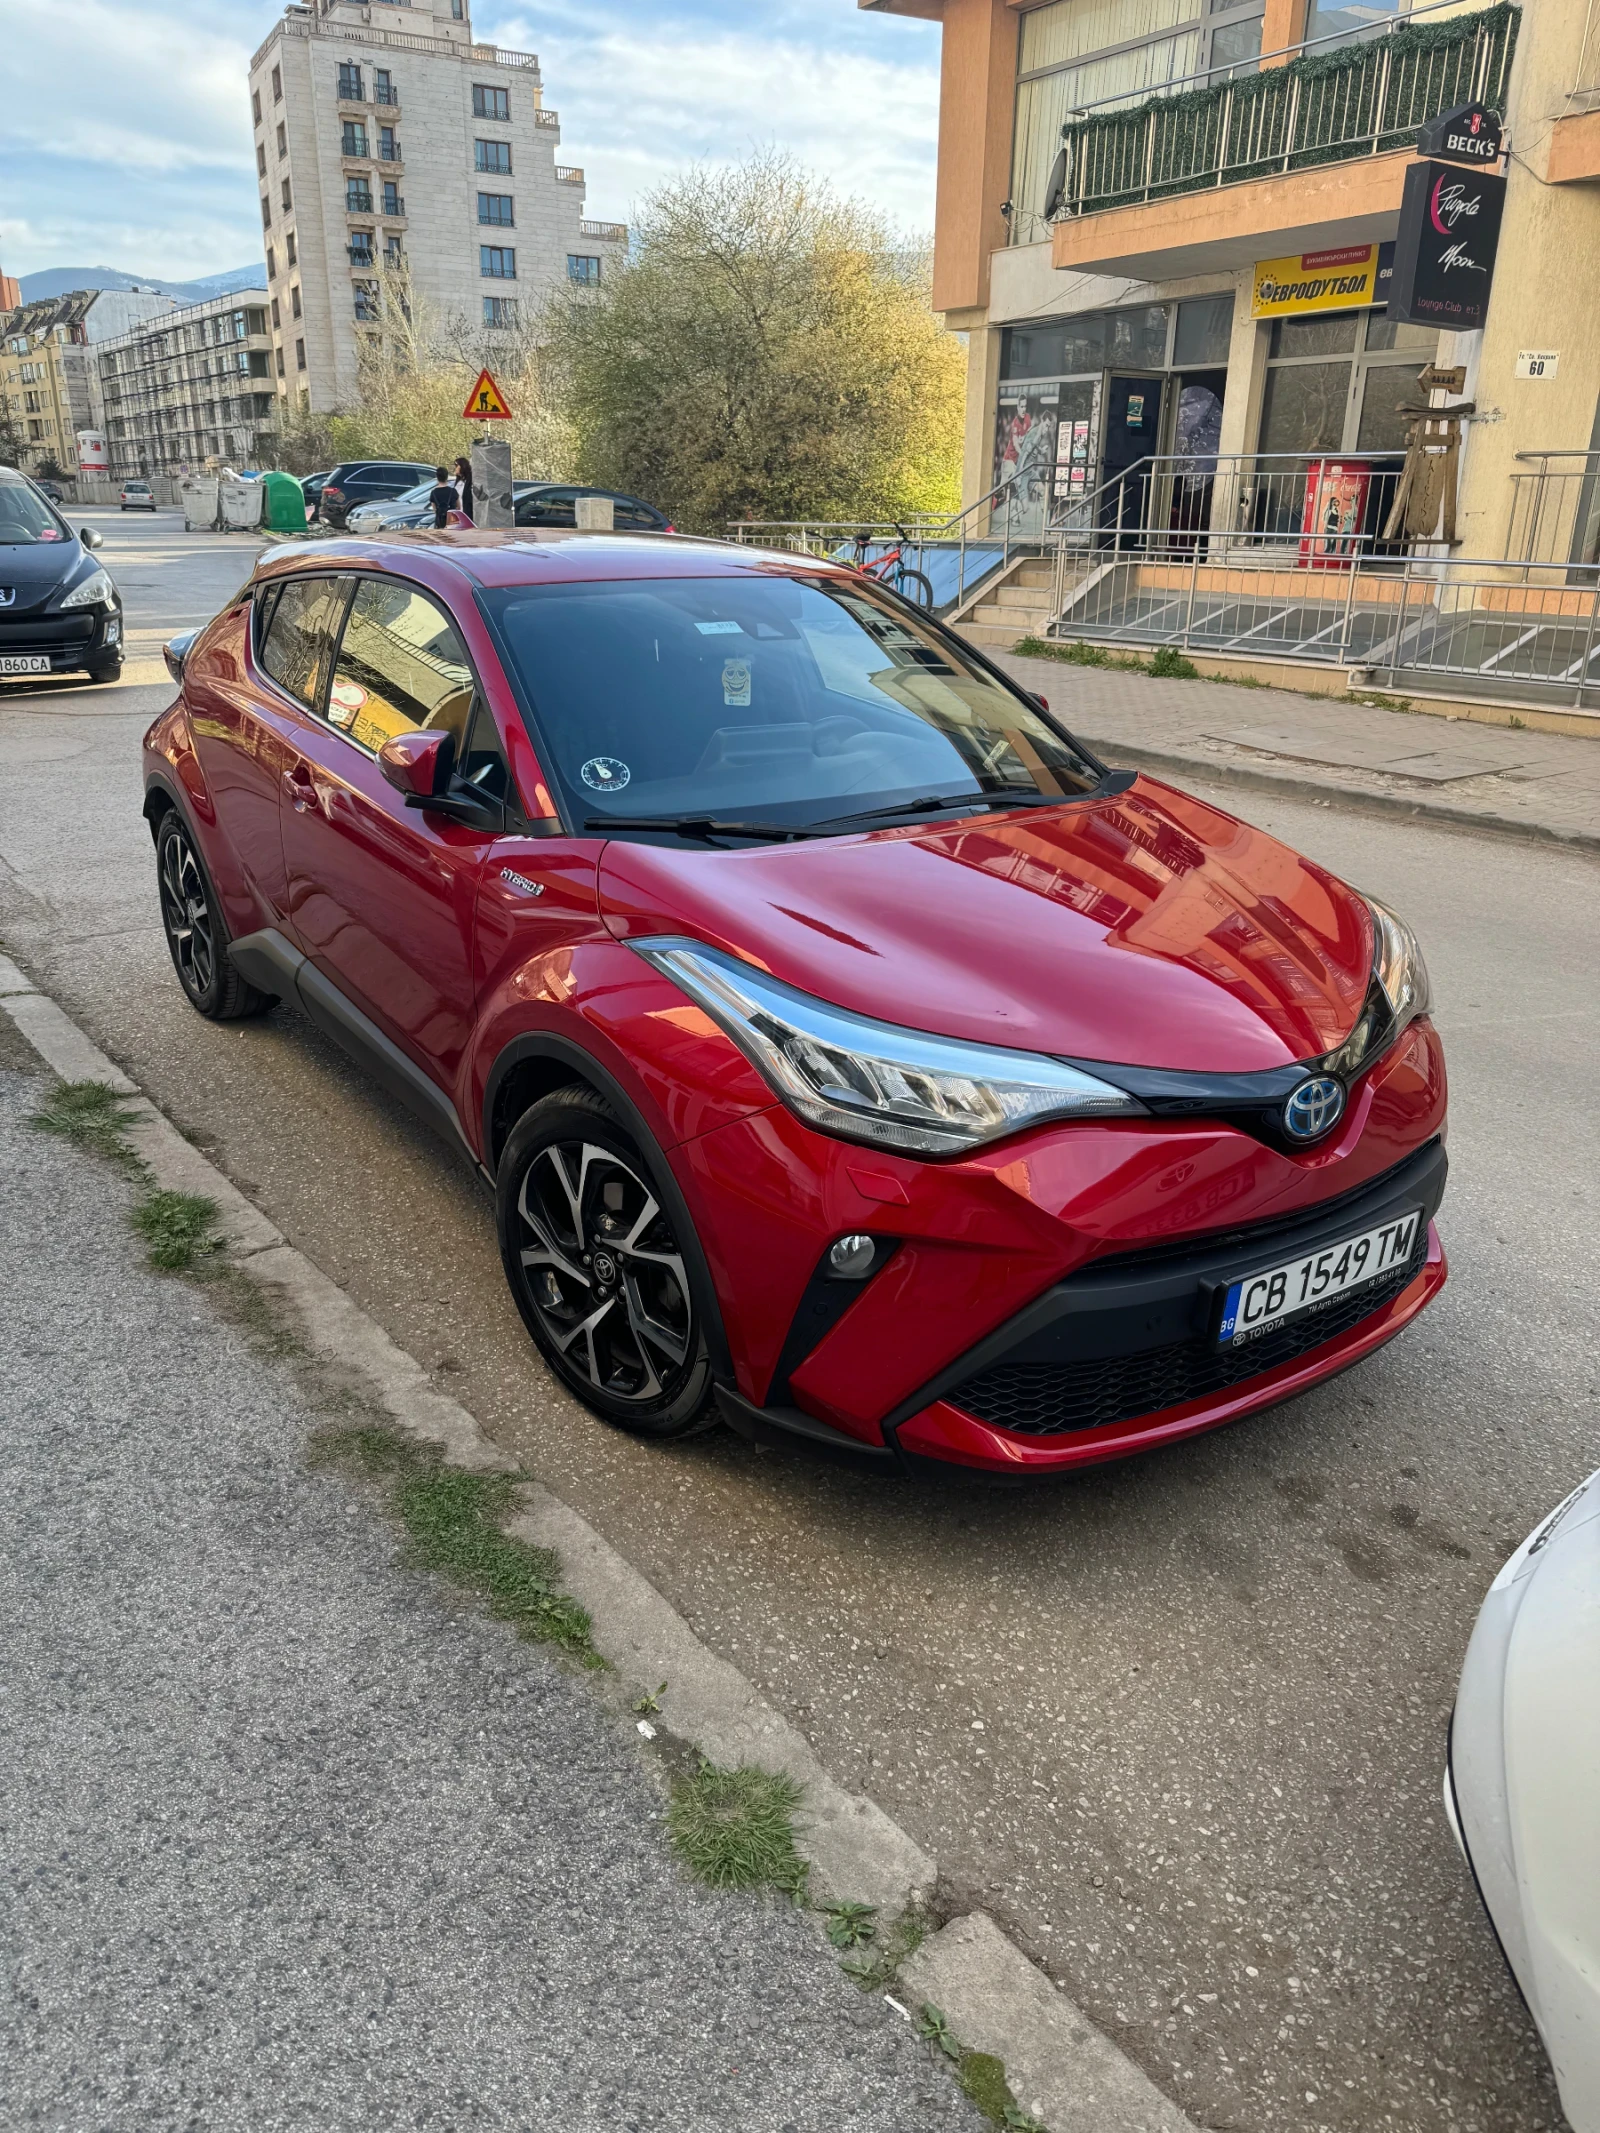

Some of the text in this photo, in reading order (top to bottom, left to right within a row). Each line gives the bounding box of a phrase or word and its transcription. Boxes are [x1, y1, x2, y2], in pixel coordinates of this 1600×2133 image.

[1446, 134, 1496, 157] BECK'S
[1438, 241, 1487, 273] Moon
[1271, 274, 1368, 303] ЕВРОФУТБОЛ
[1418, 297, 1444, 311] Lounge
[1445, 301, 1462, 312] Club
[1529, 361, 1545, 375] 60
[31, 658, 48, 670] CA
[1243, 1218, 1415, 1323] CB 1549 TM
[1220, 1318, 1234, 1333] BG
[1249, 1318, 1285, 1340] TOYOTA
